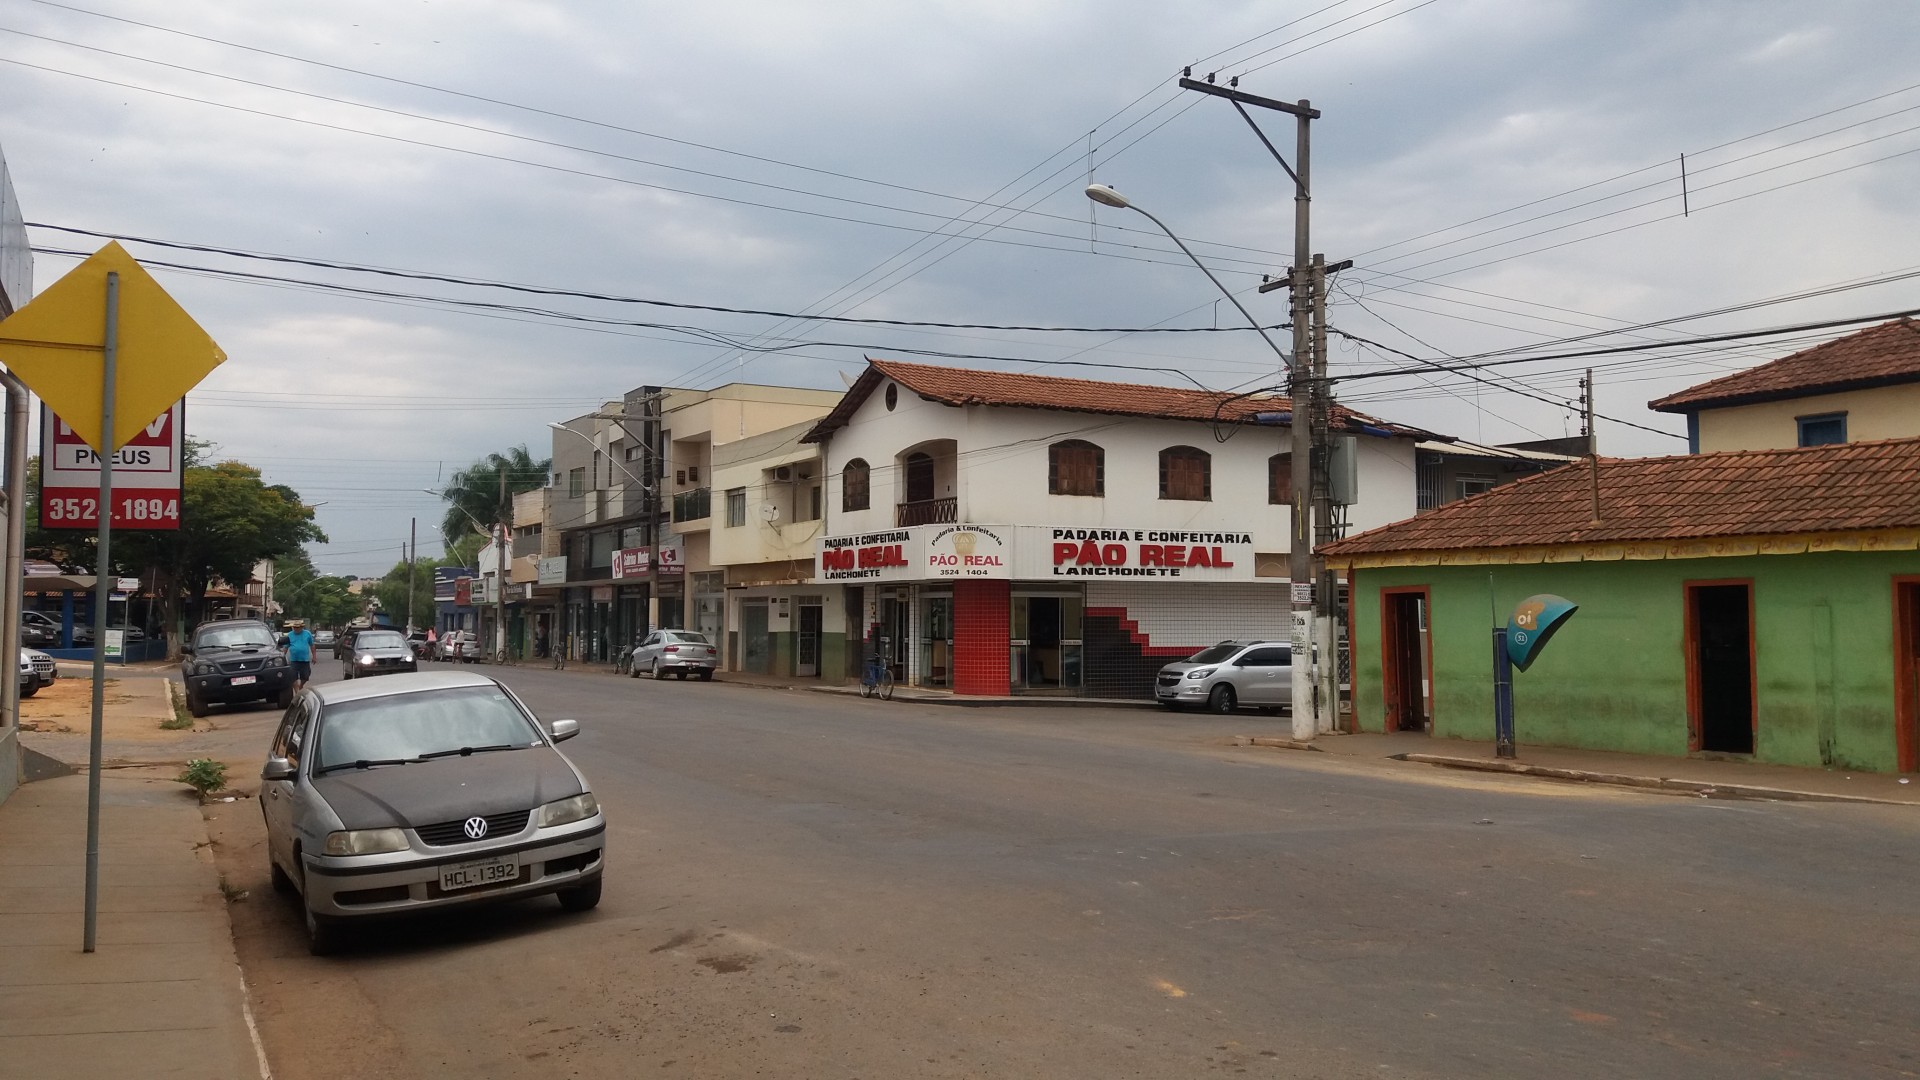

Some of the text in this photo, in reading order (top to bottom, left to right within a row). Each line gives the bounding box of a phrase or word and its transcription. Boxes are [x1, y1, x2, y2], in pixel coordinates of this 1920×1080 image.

[49, 498, 179, 520] 352.1894
[824, 531, 910, 549] PADARIA E CONFEITARIA
[931, 527, 955, 546] Padaria
[1053, 529, 1252, 544] PADARIA E CONFEITARIA
[823, 544, 909, 571] PÃO REAL
[929, 553, 1003, 566] PÃO REAL
[1053, 540, 1234, 568] PÃO REAL
[824, 569, 881, 580] LANCHONETE
[1053, 567, 1181, 577] LANCHONETE
[1518, 611, 1531, 625] oi
